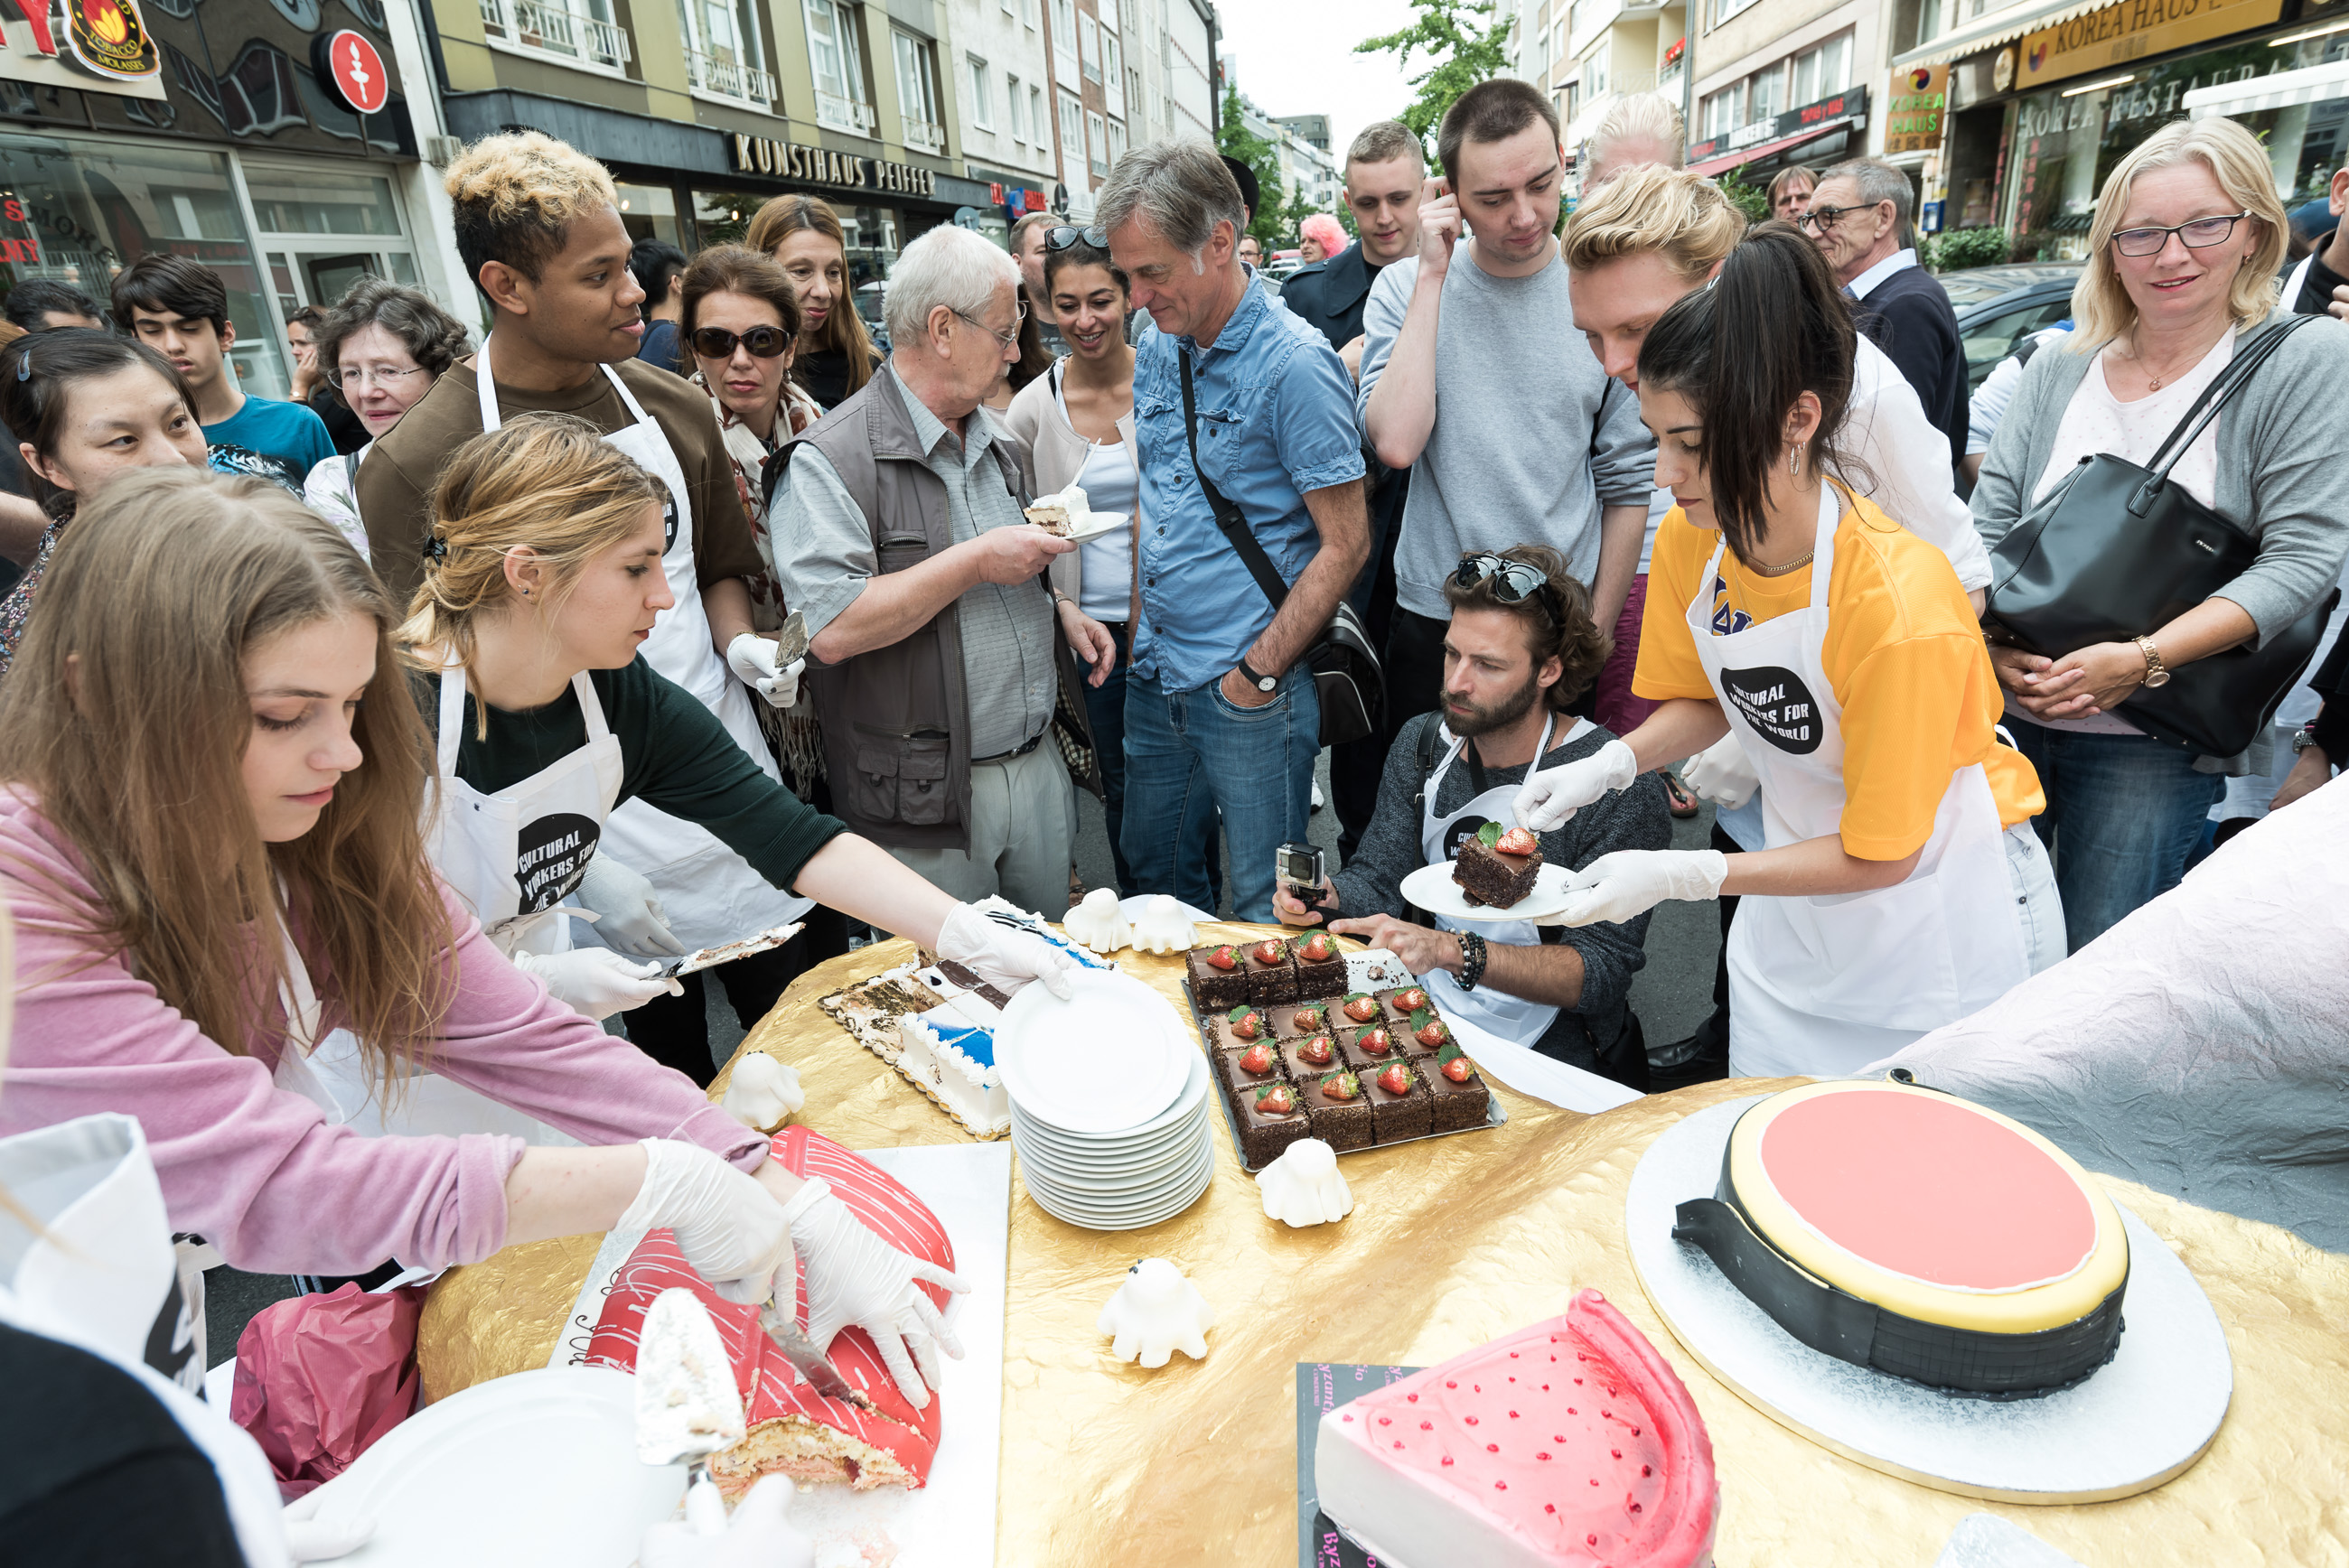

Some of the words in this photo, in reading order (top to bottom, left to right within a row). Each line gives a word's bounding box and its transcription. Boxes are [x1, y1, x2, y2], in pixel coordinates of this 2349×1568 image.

[2054, 7, 2124, 54] KOREA
[89, 32, 137, 56] TOBACCO
[98, 53, 145, 70] MOLASSES
[1889, 93, 1943, 113] KOREA
[1892, 113, 1937, 135] HAUS
[2020, 101, 2094, 136] KOREA
[735, 133, 866, 187] KUNSTHAUS
[1731, 683, 1786, 706] CULTURAL
[1729, 692, 1777, 724] WORKERS
[1783, 703, 1810, 723] FOR
[1764, 723, 1810, 741] WORLD
